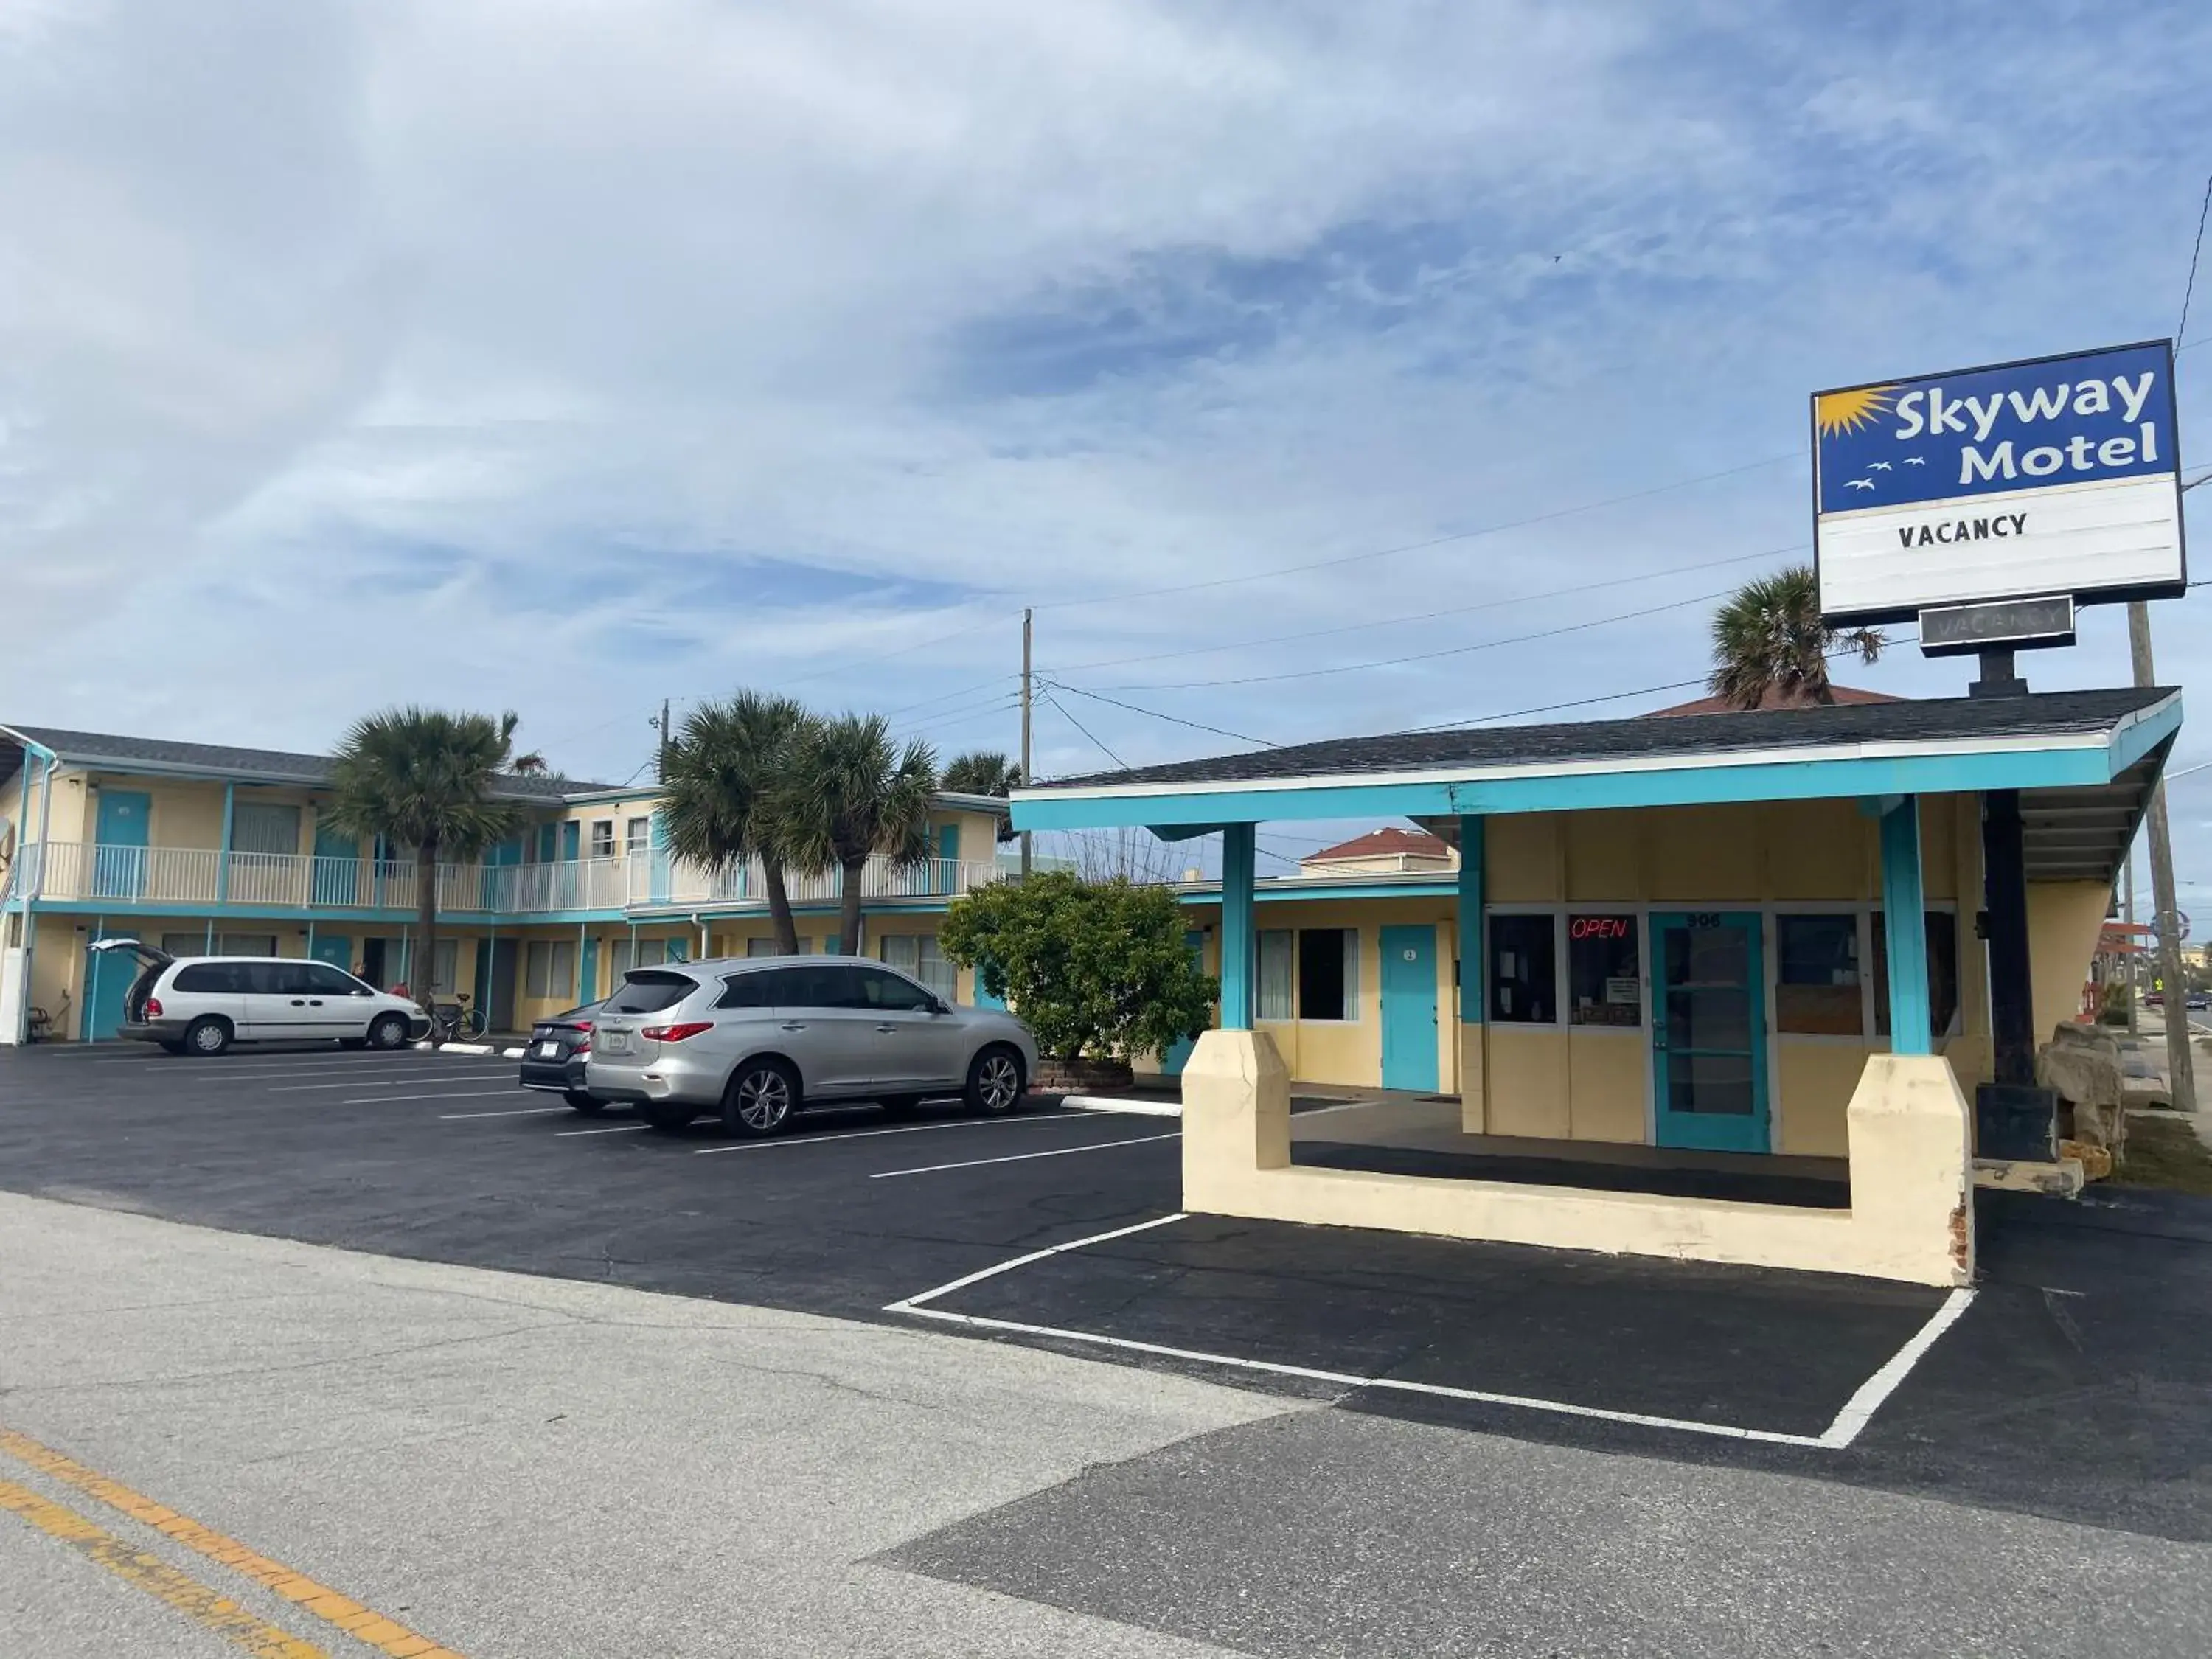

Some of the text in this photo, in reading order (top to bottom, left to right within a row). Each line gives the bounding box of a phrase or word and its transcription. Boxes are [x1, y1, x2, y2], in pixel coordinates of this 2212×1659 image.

[1896, 372, 2154, 442] Skyway
[1959, 422, 2157, 484] Motel
[1899, 513, 2028, 548] VACANCY
[1938, 607, 2062, 636] VACANCY
[1572, 919, 1628, 939] OPEN
